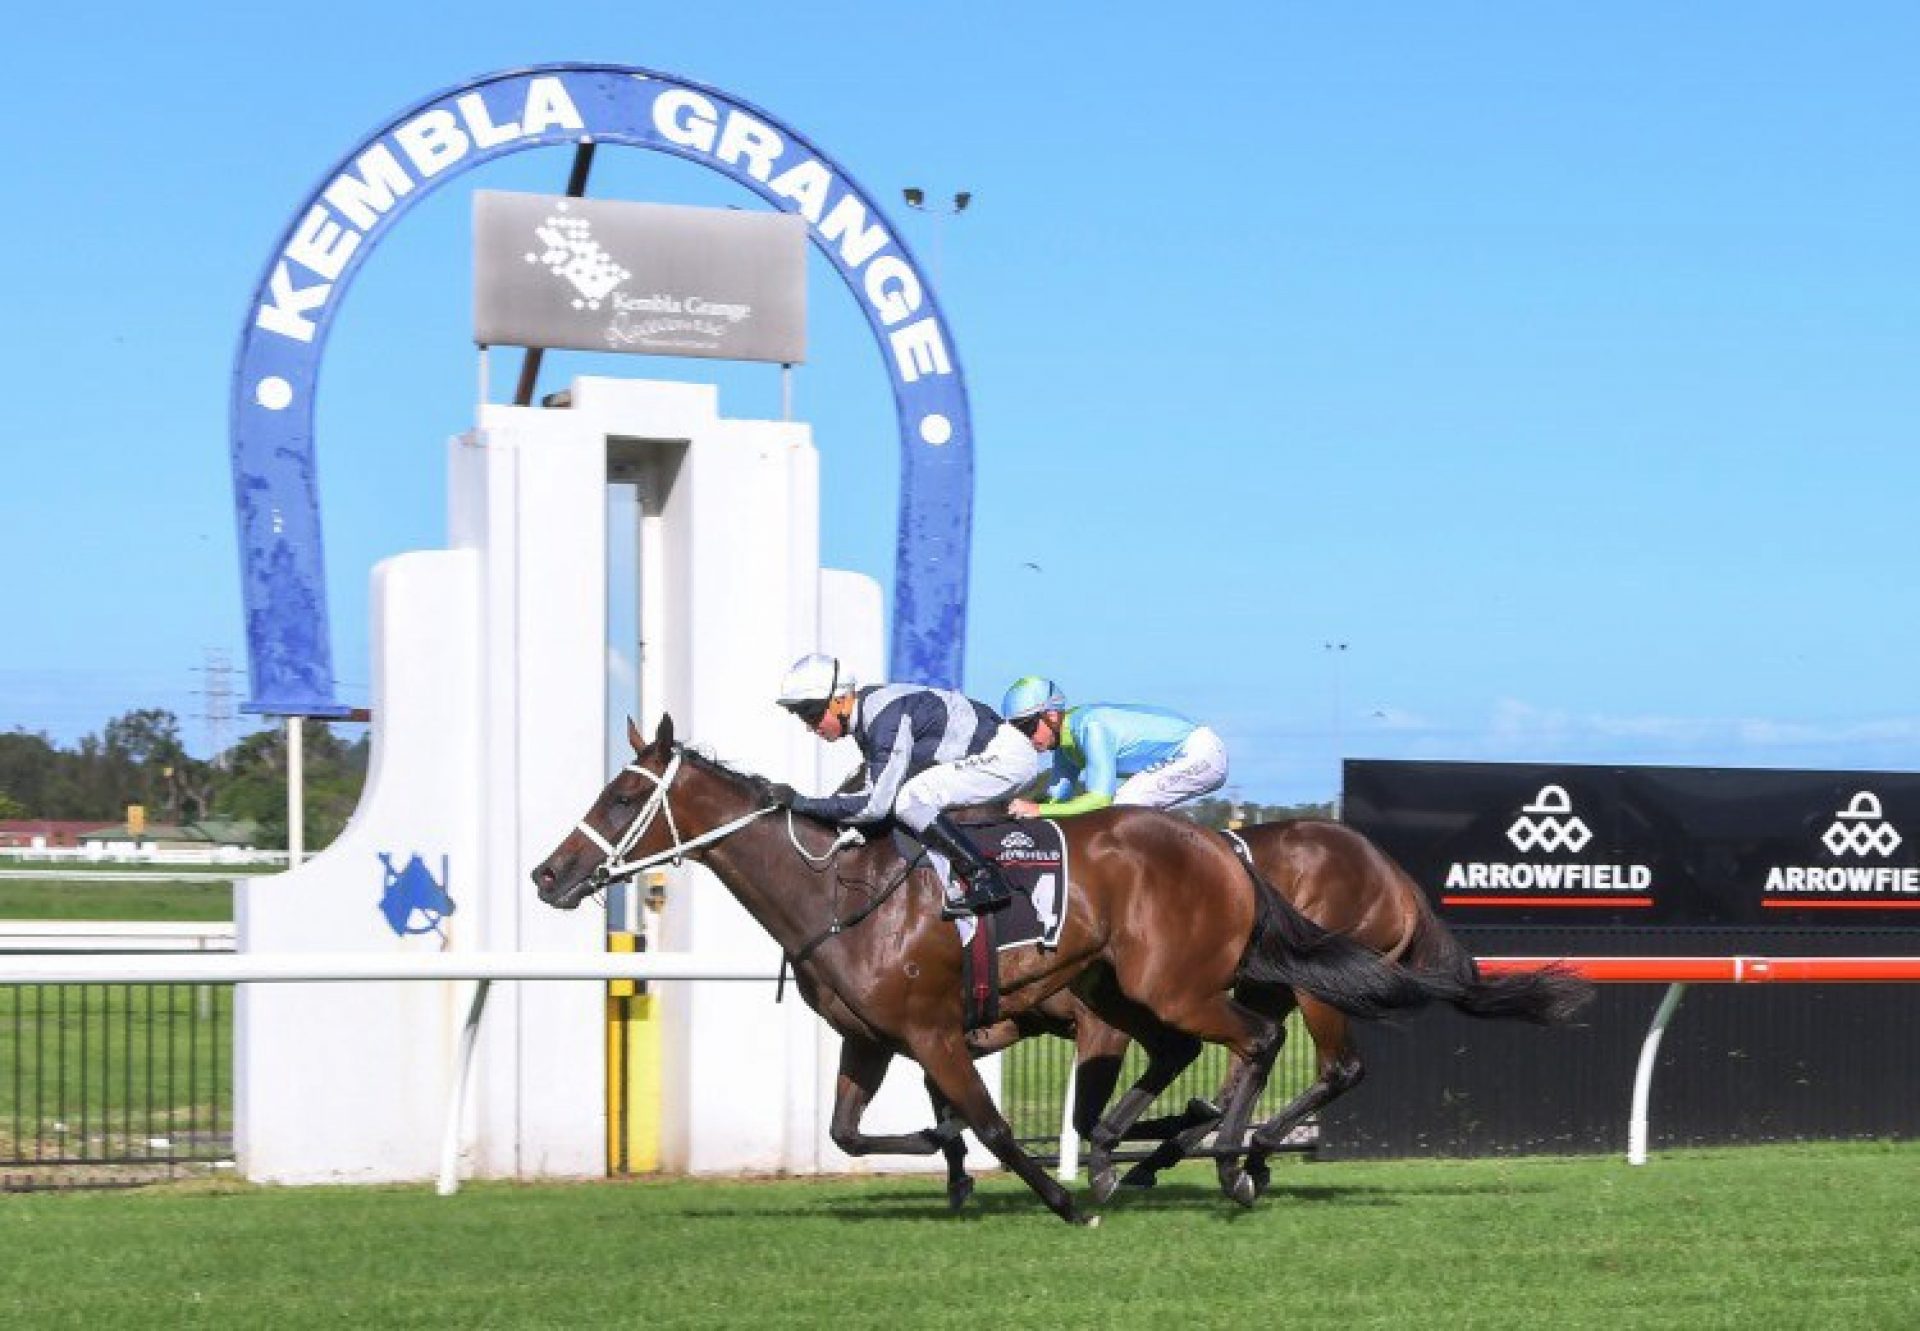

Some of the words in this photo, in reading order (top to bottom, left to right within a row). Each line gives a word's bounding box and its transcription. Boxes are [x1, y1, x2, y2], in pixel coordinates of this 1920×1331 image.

[256, 76, 584, 343] KEMBLA
[652, 88, 952, 382] GRANGE
[1446, 863, 1652, 889] ARROWFIELD
